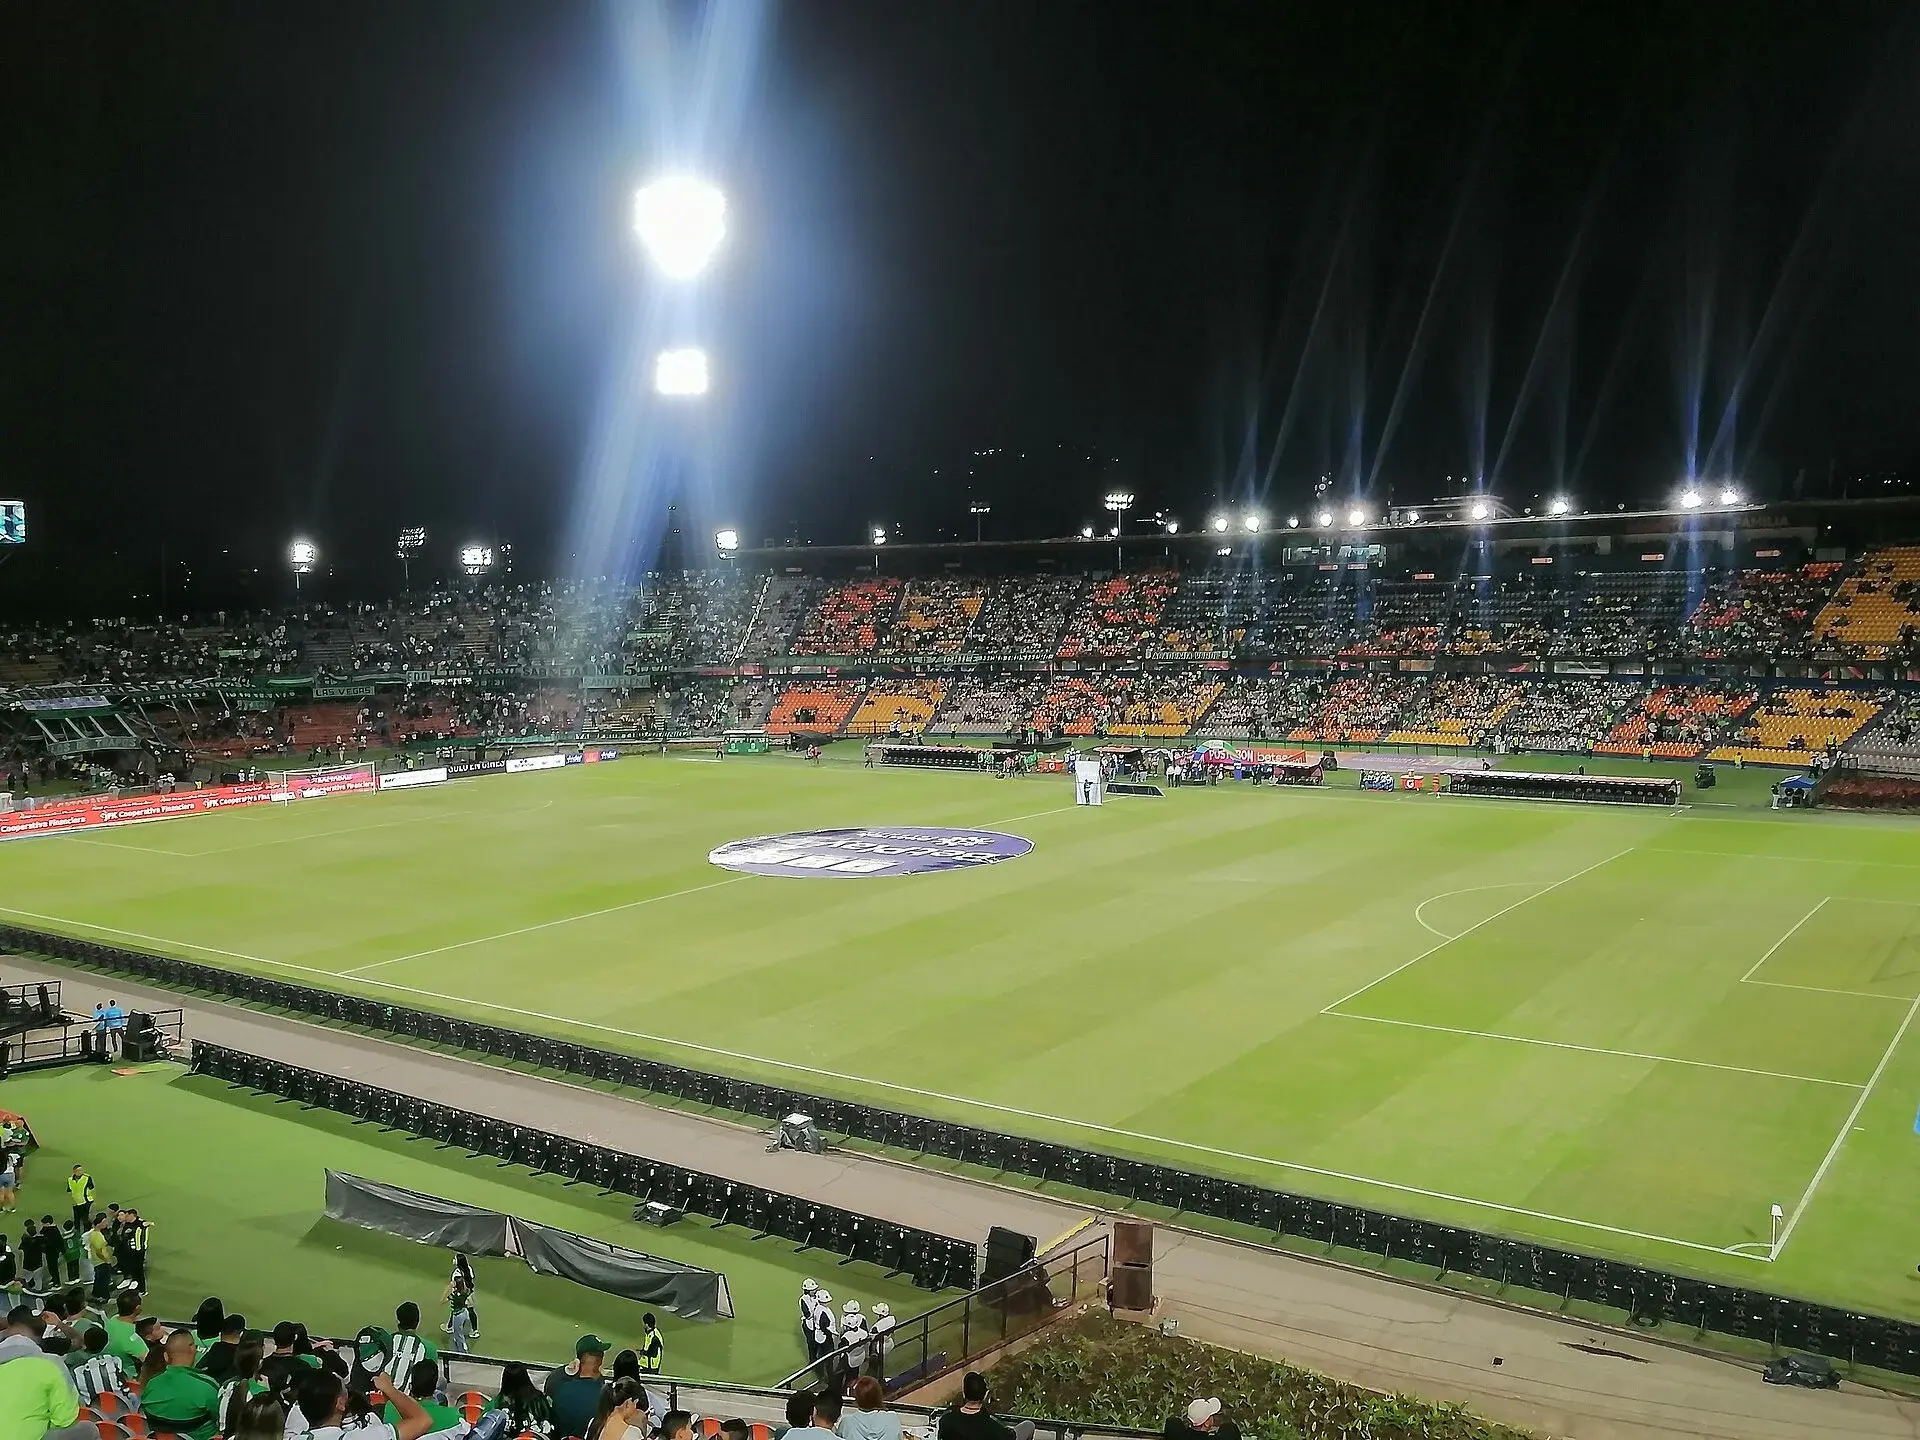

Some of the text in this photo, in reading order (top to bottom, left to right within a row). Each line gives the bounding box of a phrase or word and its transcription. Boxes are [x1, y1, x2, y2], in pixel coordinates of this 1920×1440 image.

[944, 655, 977, 664] CHILE
[315, 687, 371, 697] LAS VEGAS
[95, 738, 137, 748] TRAPOS
[1209, 749, 1253, 762] POSTBON
[219, 794, 257, 806] Cooperativa
[119, 806, 160, 818] Cooperativa
[161, 803, 194, 812] Financiera
[1, 816, 86, 833] Cooperativa Financiera
